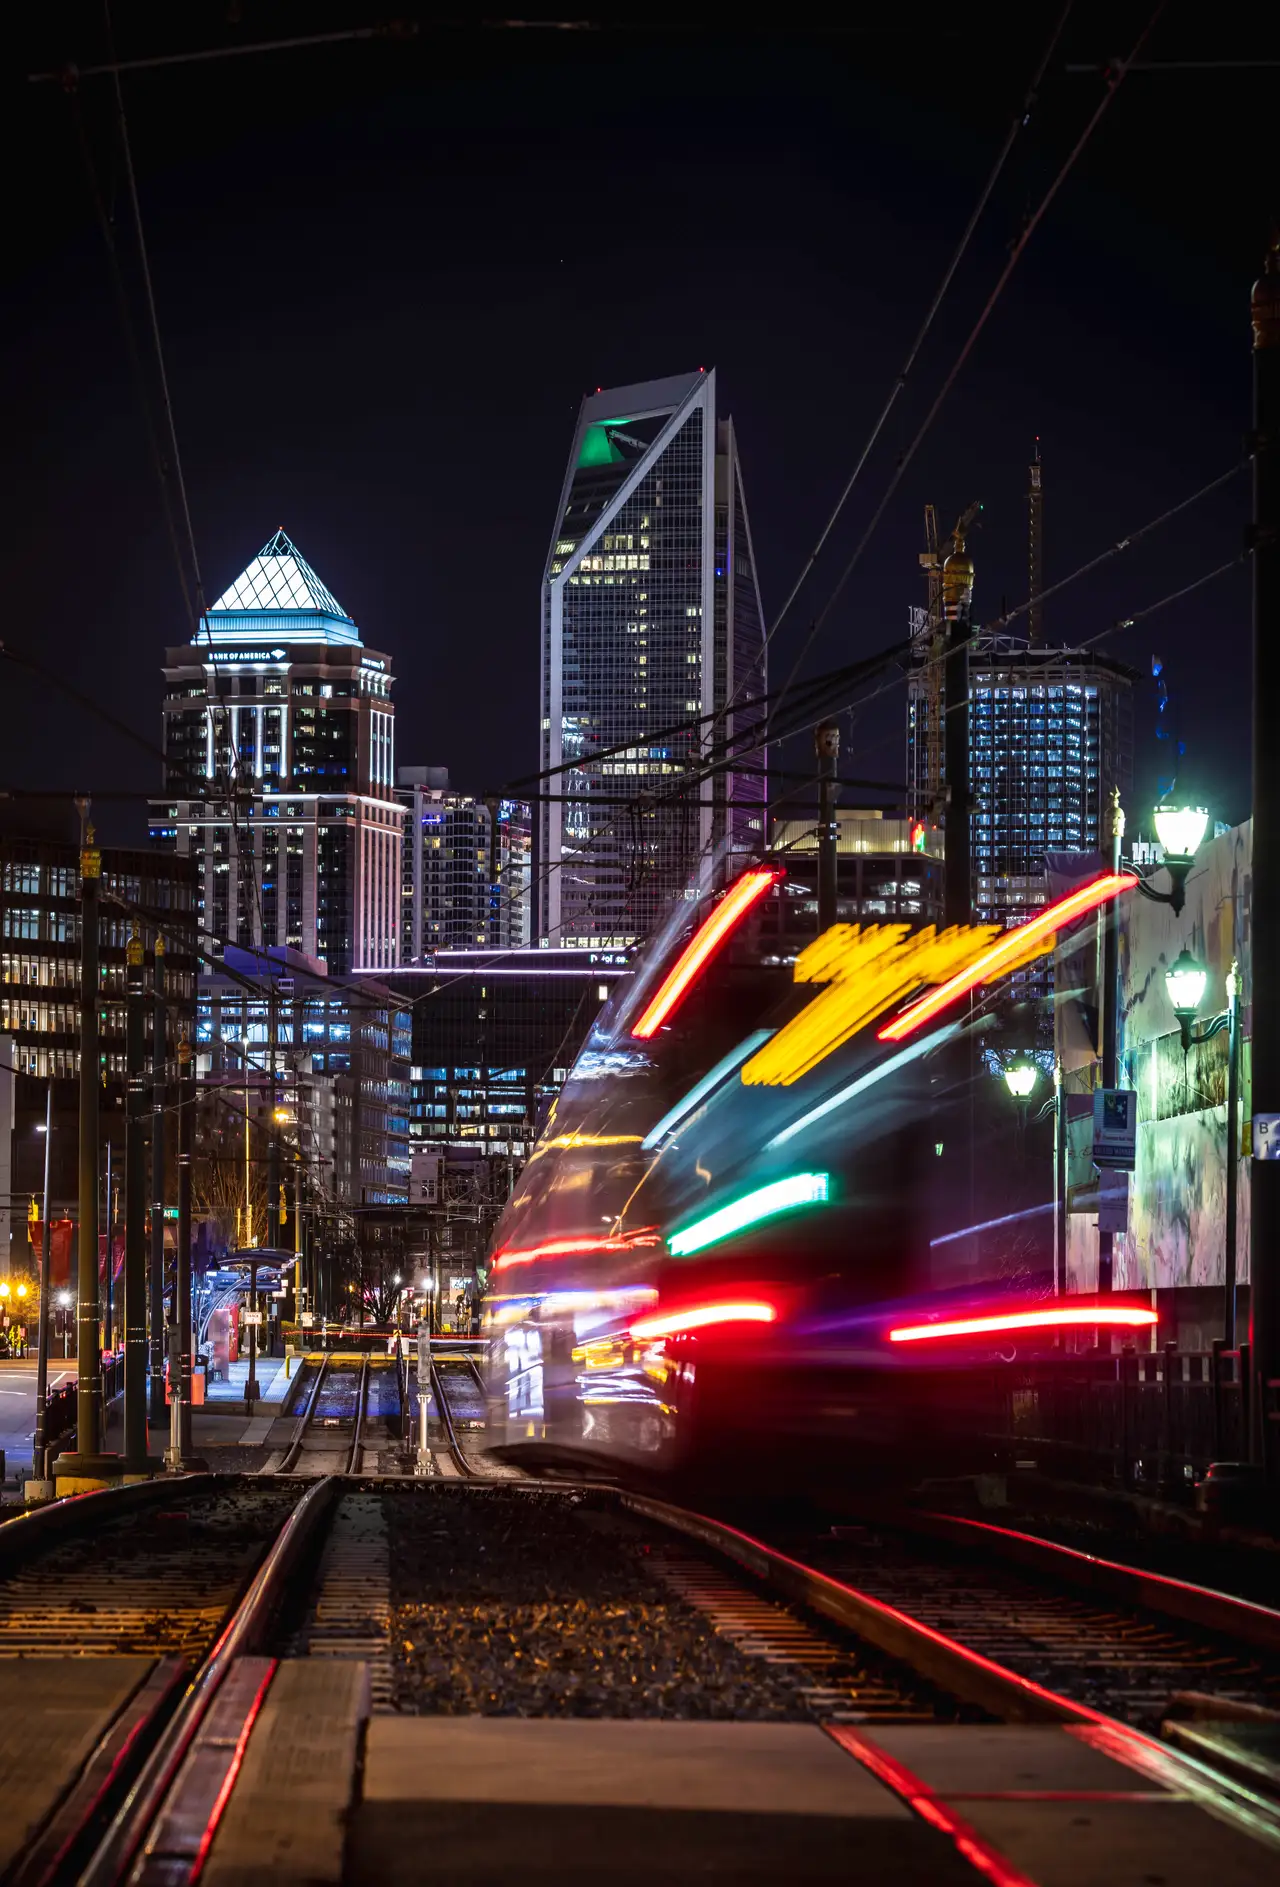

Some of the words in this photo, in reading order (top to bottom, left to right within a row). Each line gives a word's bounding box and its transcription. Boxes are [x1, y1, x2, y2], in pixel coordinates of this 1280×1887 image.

[208, 652, 228, 661] BANK
[229, 652, 239, 660] OF
[239, 652, 271, 660] AMERICA
[1259, 1121, 1269, 1134] B
